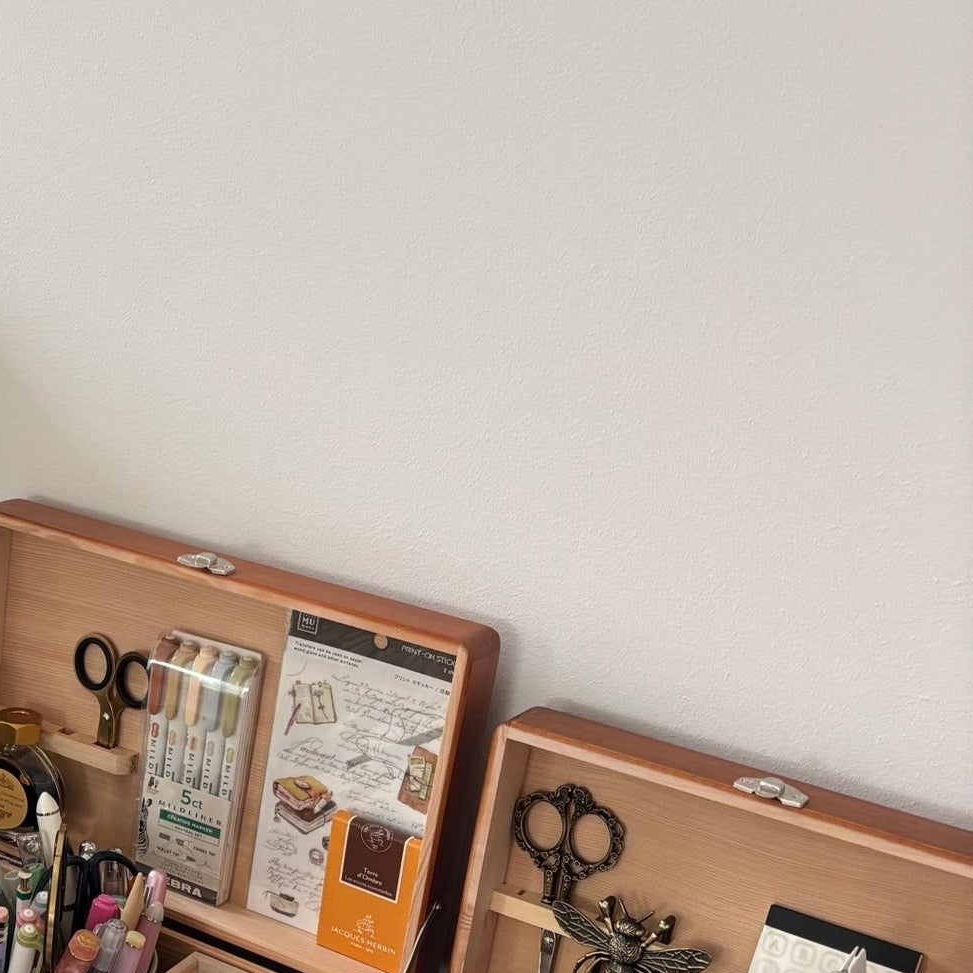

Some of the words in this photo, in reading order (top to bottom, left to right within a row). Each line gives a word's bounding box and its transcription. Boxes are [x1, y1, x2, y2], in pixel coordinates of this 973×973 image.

[180, 789, 203, 809] 5ct
[158, 800, 222, 826] MILDLINER
[191, 822, 213, 834] MARKER
[364, 867, 379, 878] Terre
[166, 876, 203, 898] EBRA
[331, 925, 365, 945] JACQUES
[367, 940, 396, 956] HERBIN
